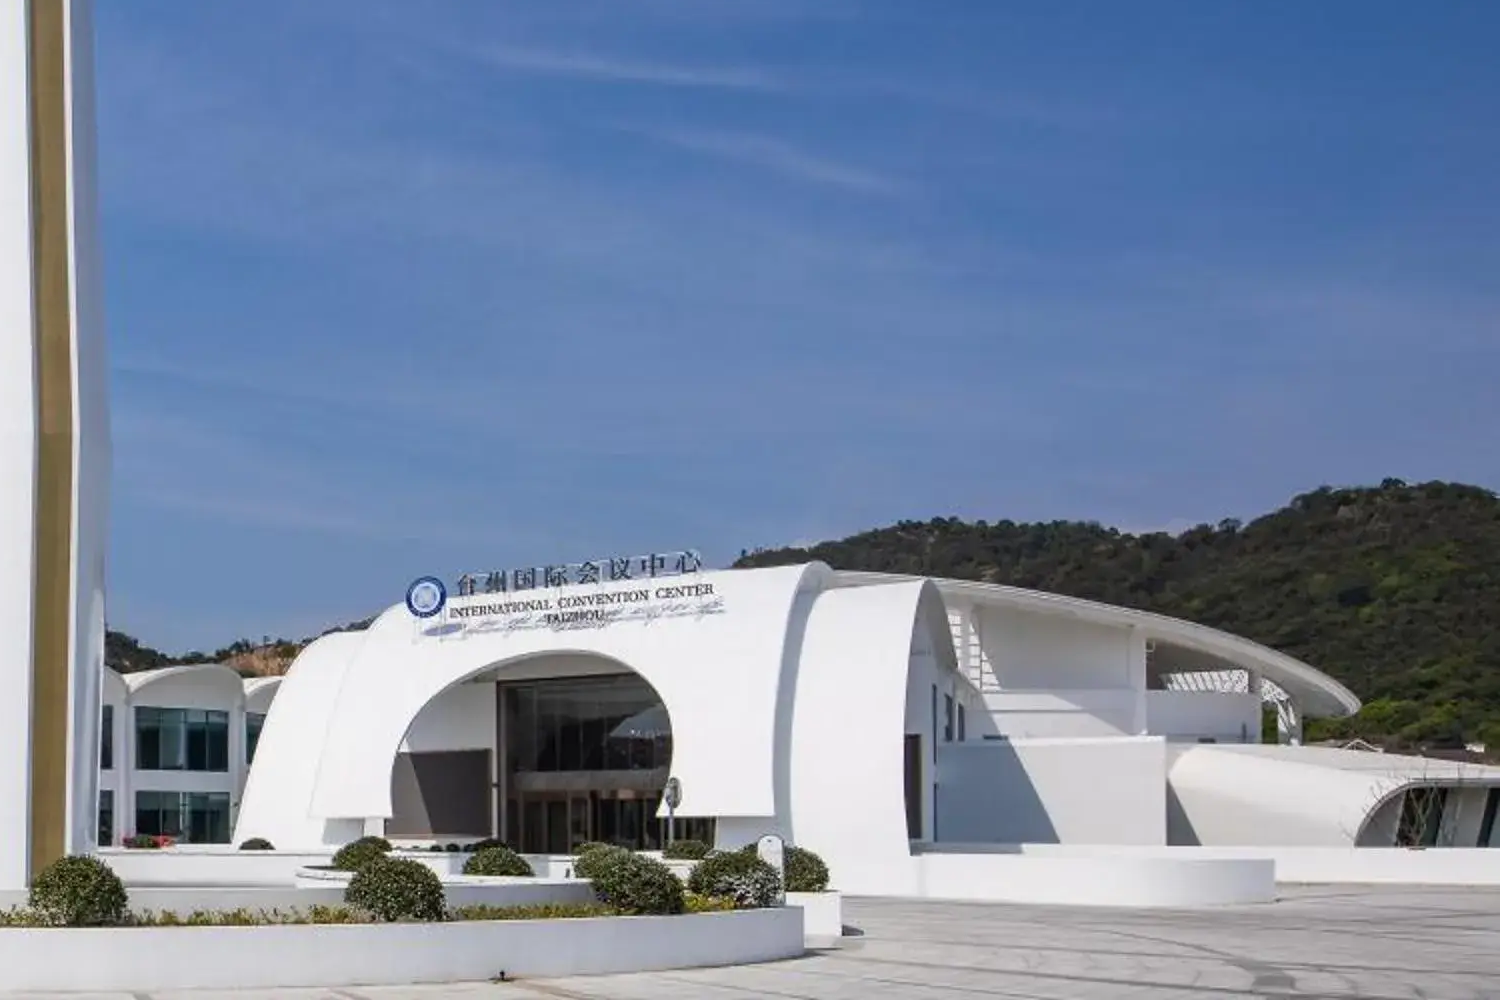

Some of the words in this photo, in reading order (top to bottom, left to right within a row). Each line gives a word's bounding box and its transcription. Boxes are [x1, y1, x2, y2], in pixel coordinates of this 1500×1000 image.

[457, 549, 702, 597] 台州国际会议中心
[449, 599, 553, 618] INTERNATIONAL
[557, 589, 650, 608] CONVENTION
[655, 583, 714, 598] CENTER
[545, 609, 604, 624] TAIZHOU
